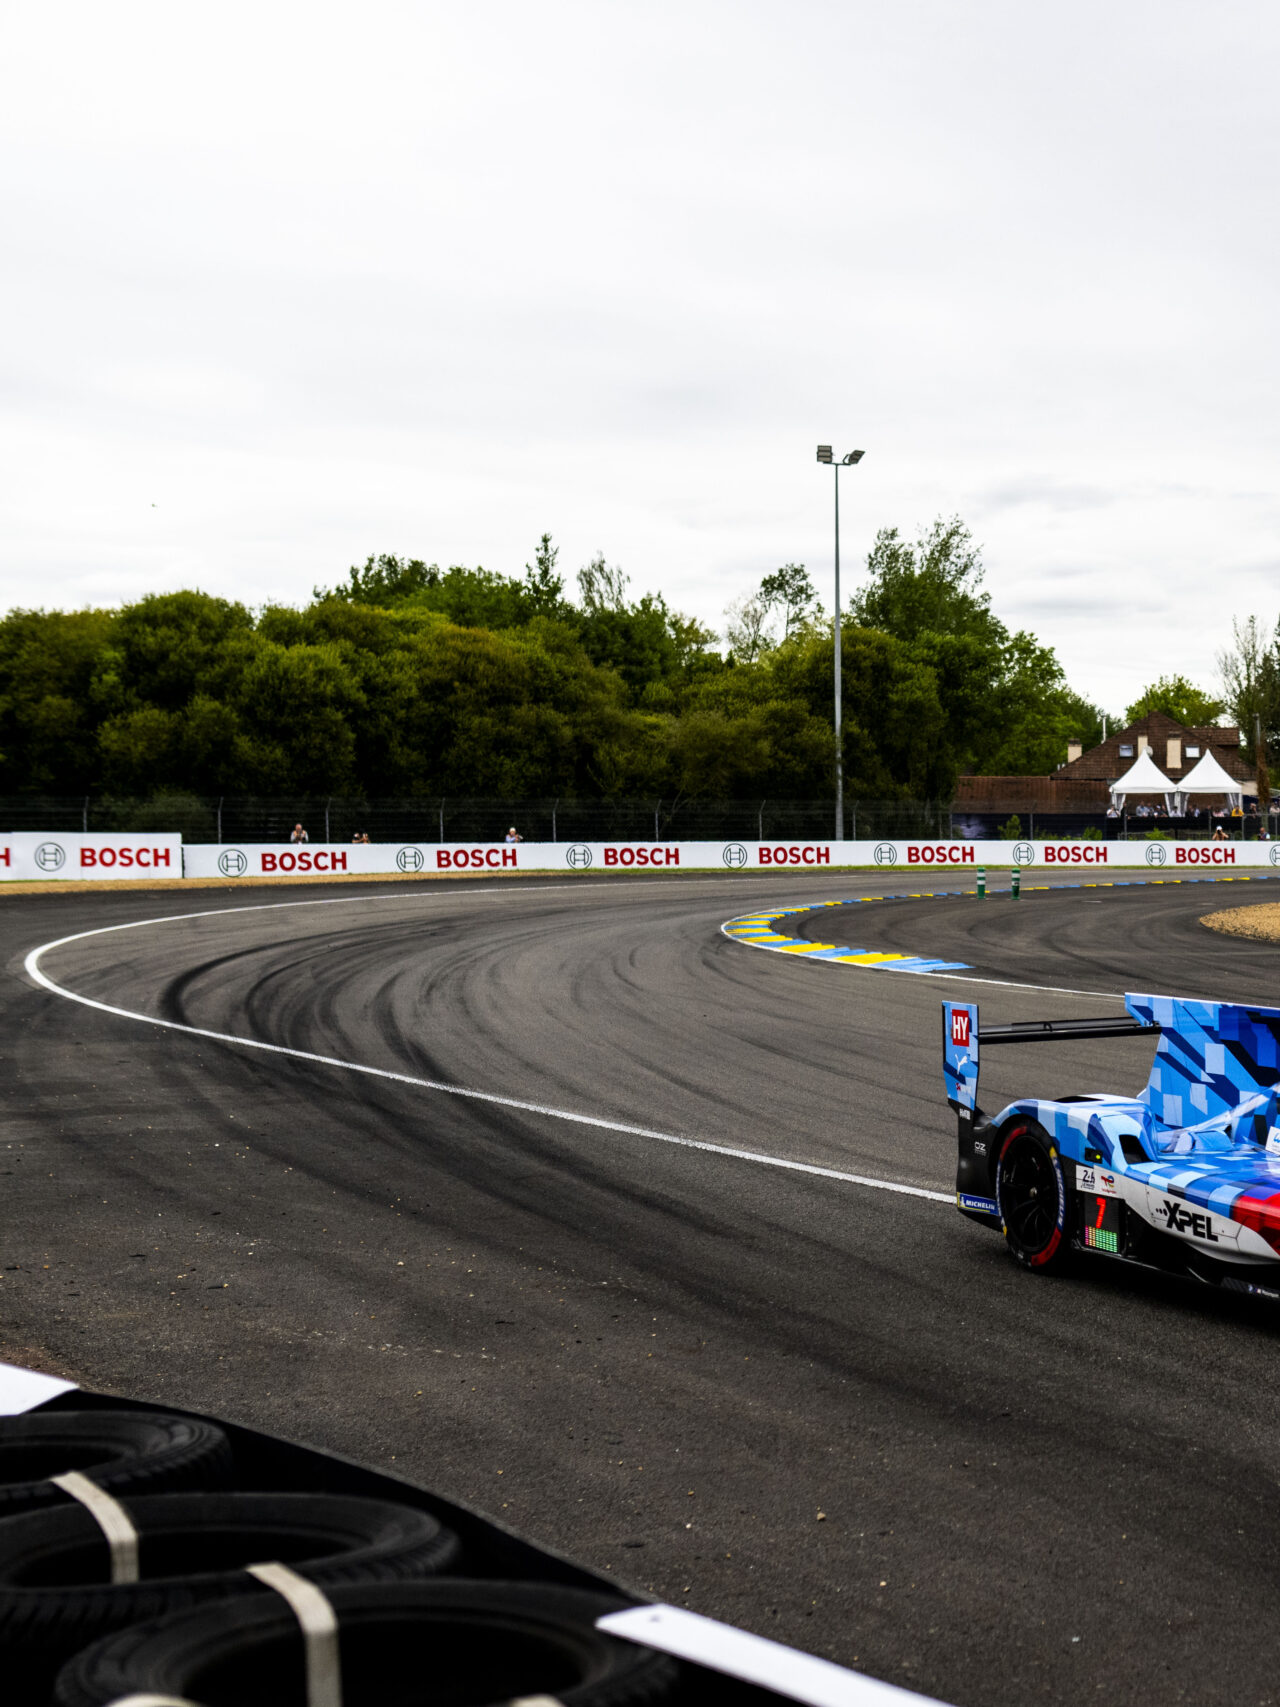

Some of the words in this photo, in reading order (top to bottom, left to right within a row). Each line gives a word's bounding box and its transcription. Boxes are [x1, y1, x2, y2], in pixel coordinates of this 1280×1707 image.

[80, 847, 170, 868] BOSCH
[261, 851, 347, 872] BOSCH
[436, 848, 517, 869] BOSCH
[604, 847, 680, 866] BOSCH
[759, 846, 830, 865] BOSCH
[907, 846, 975, 864] BOSCH
[1044, 846, 1108, 864] BOSCH
[1175, 847, 1235, 864] BOSCH
[953, 1016, 968, 1040] HY
[966, 1199, 995, 1210] MICHELIN
[1096, 1197, 1106, 1229] 7
[1163, 1200, 1219, 1242] XPEL
